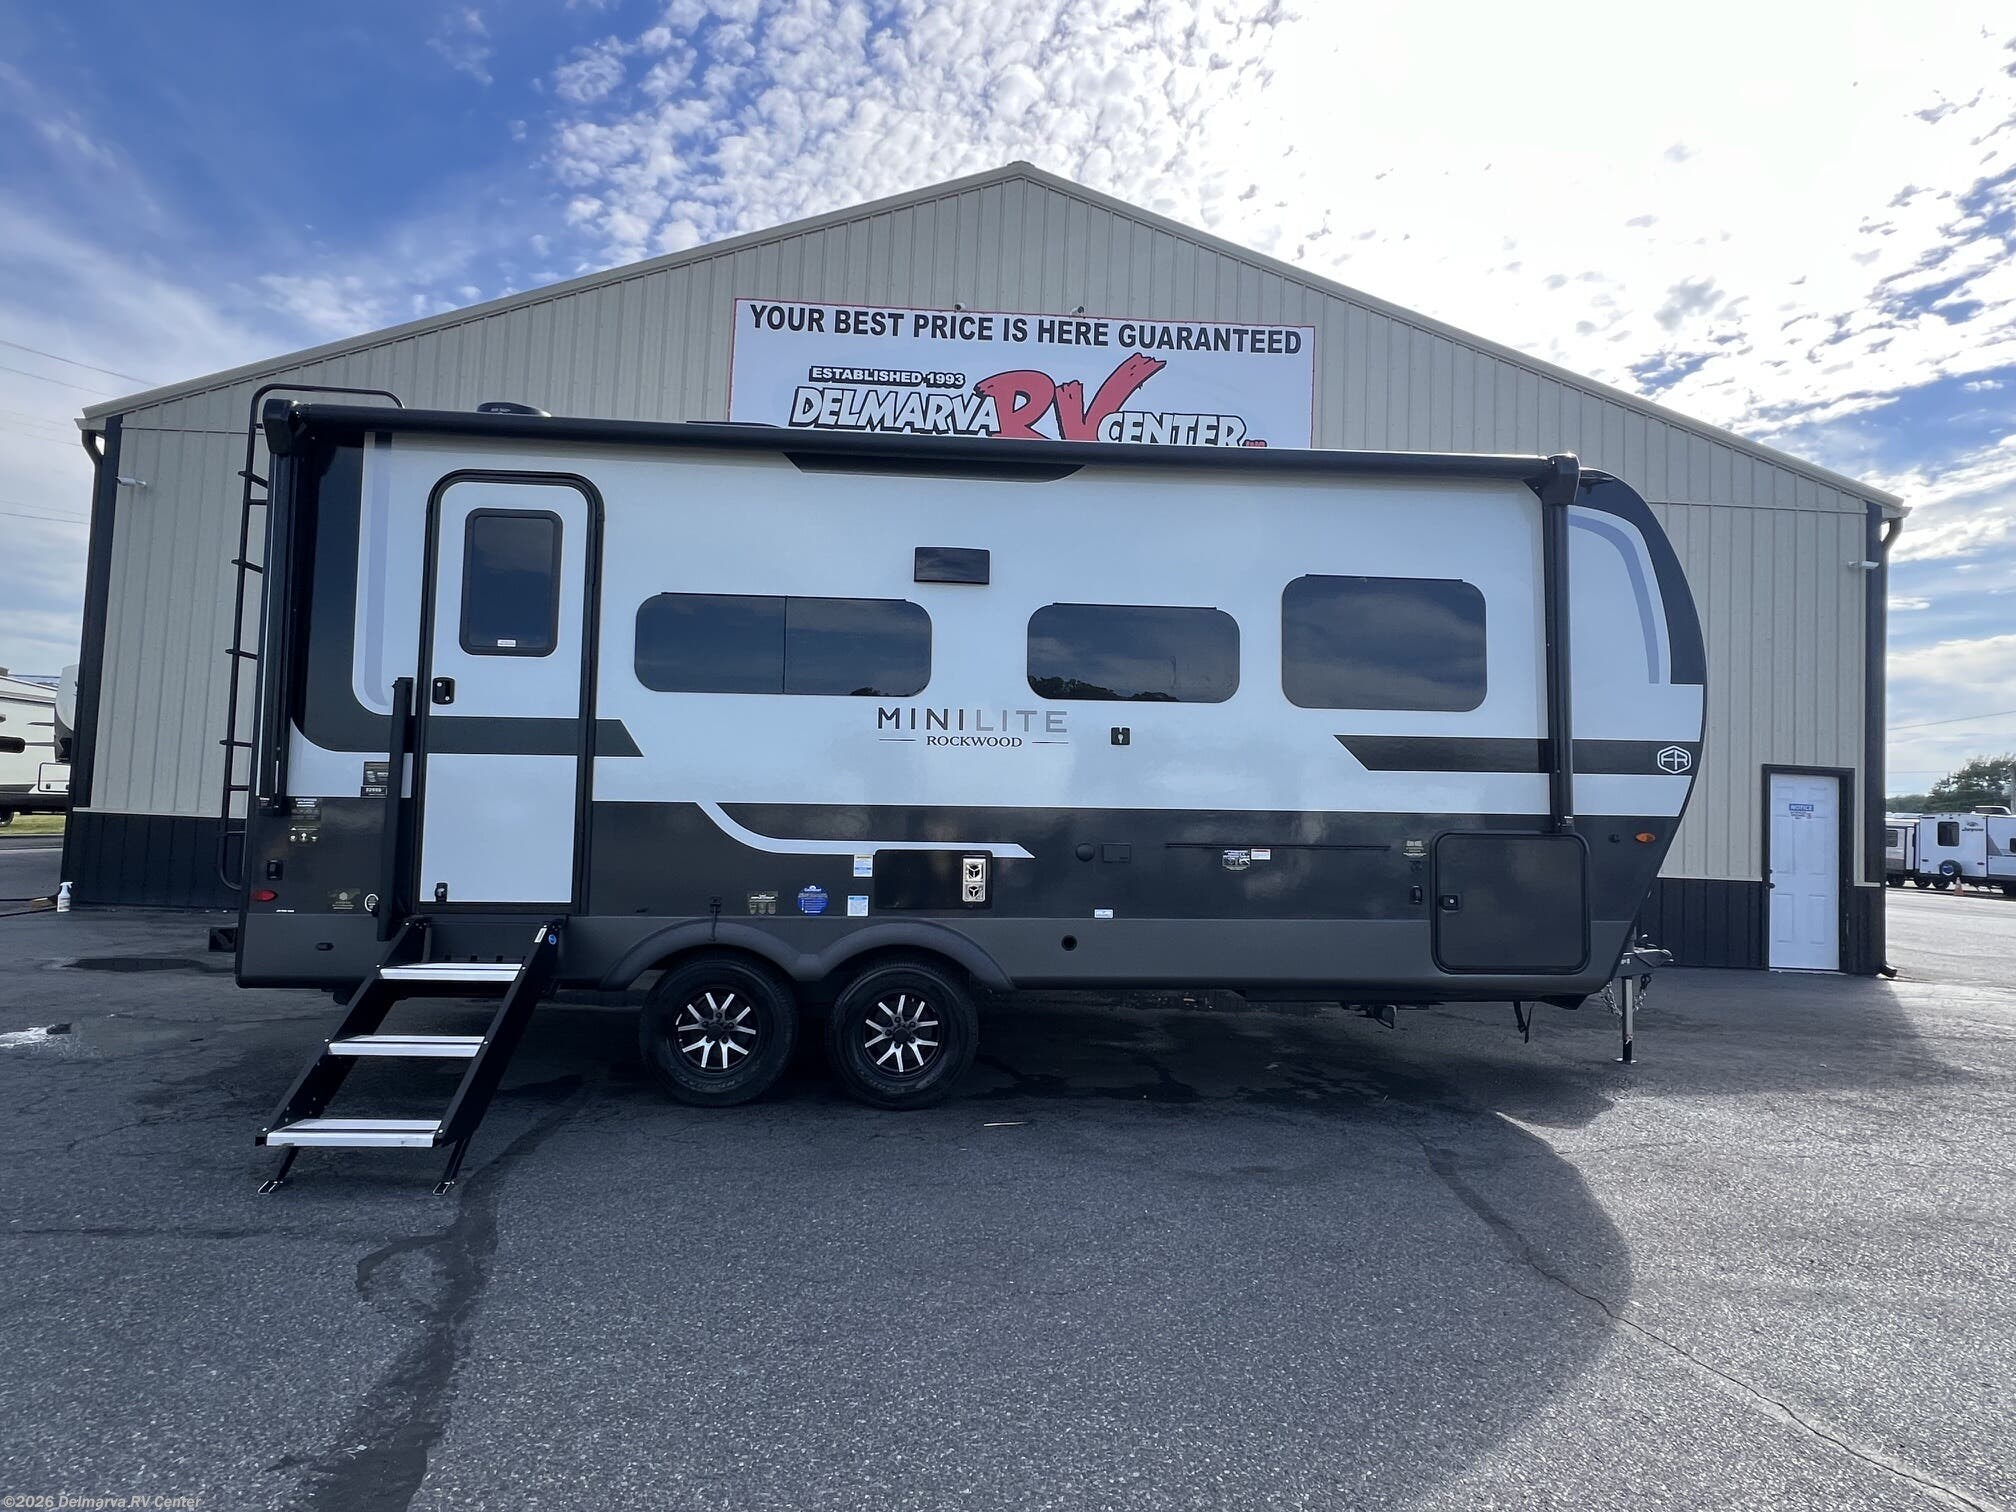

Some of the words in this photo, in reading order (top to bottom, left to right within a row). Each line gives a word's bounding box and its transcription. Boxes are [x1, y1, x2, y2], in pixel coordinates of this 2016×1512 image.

[750, 304, 825, 333] YOUR
[834, 310, 904, 337] BEST
[913, 314, 993, 341] PRICE
[1003, 318, 1028, 342] IS
[1038, 320, 1109, 347] HERE
[1118, 324, 1301, 354] GUARANTEED
[811, 367, 923, 385] ESTABLISHED
[926, 373, 965, 386] 1993
[789, 386, 1001, 433] DELMARVA
[974, 352, 1167, 440] RV
[1097, 411, 1246, 446] CENTER
[926, 735, 1023, 748] ROCKWOOD
